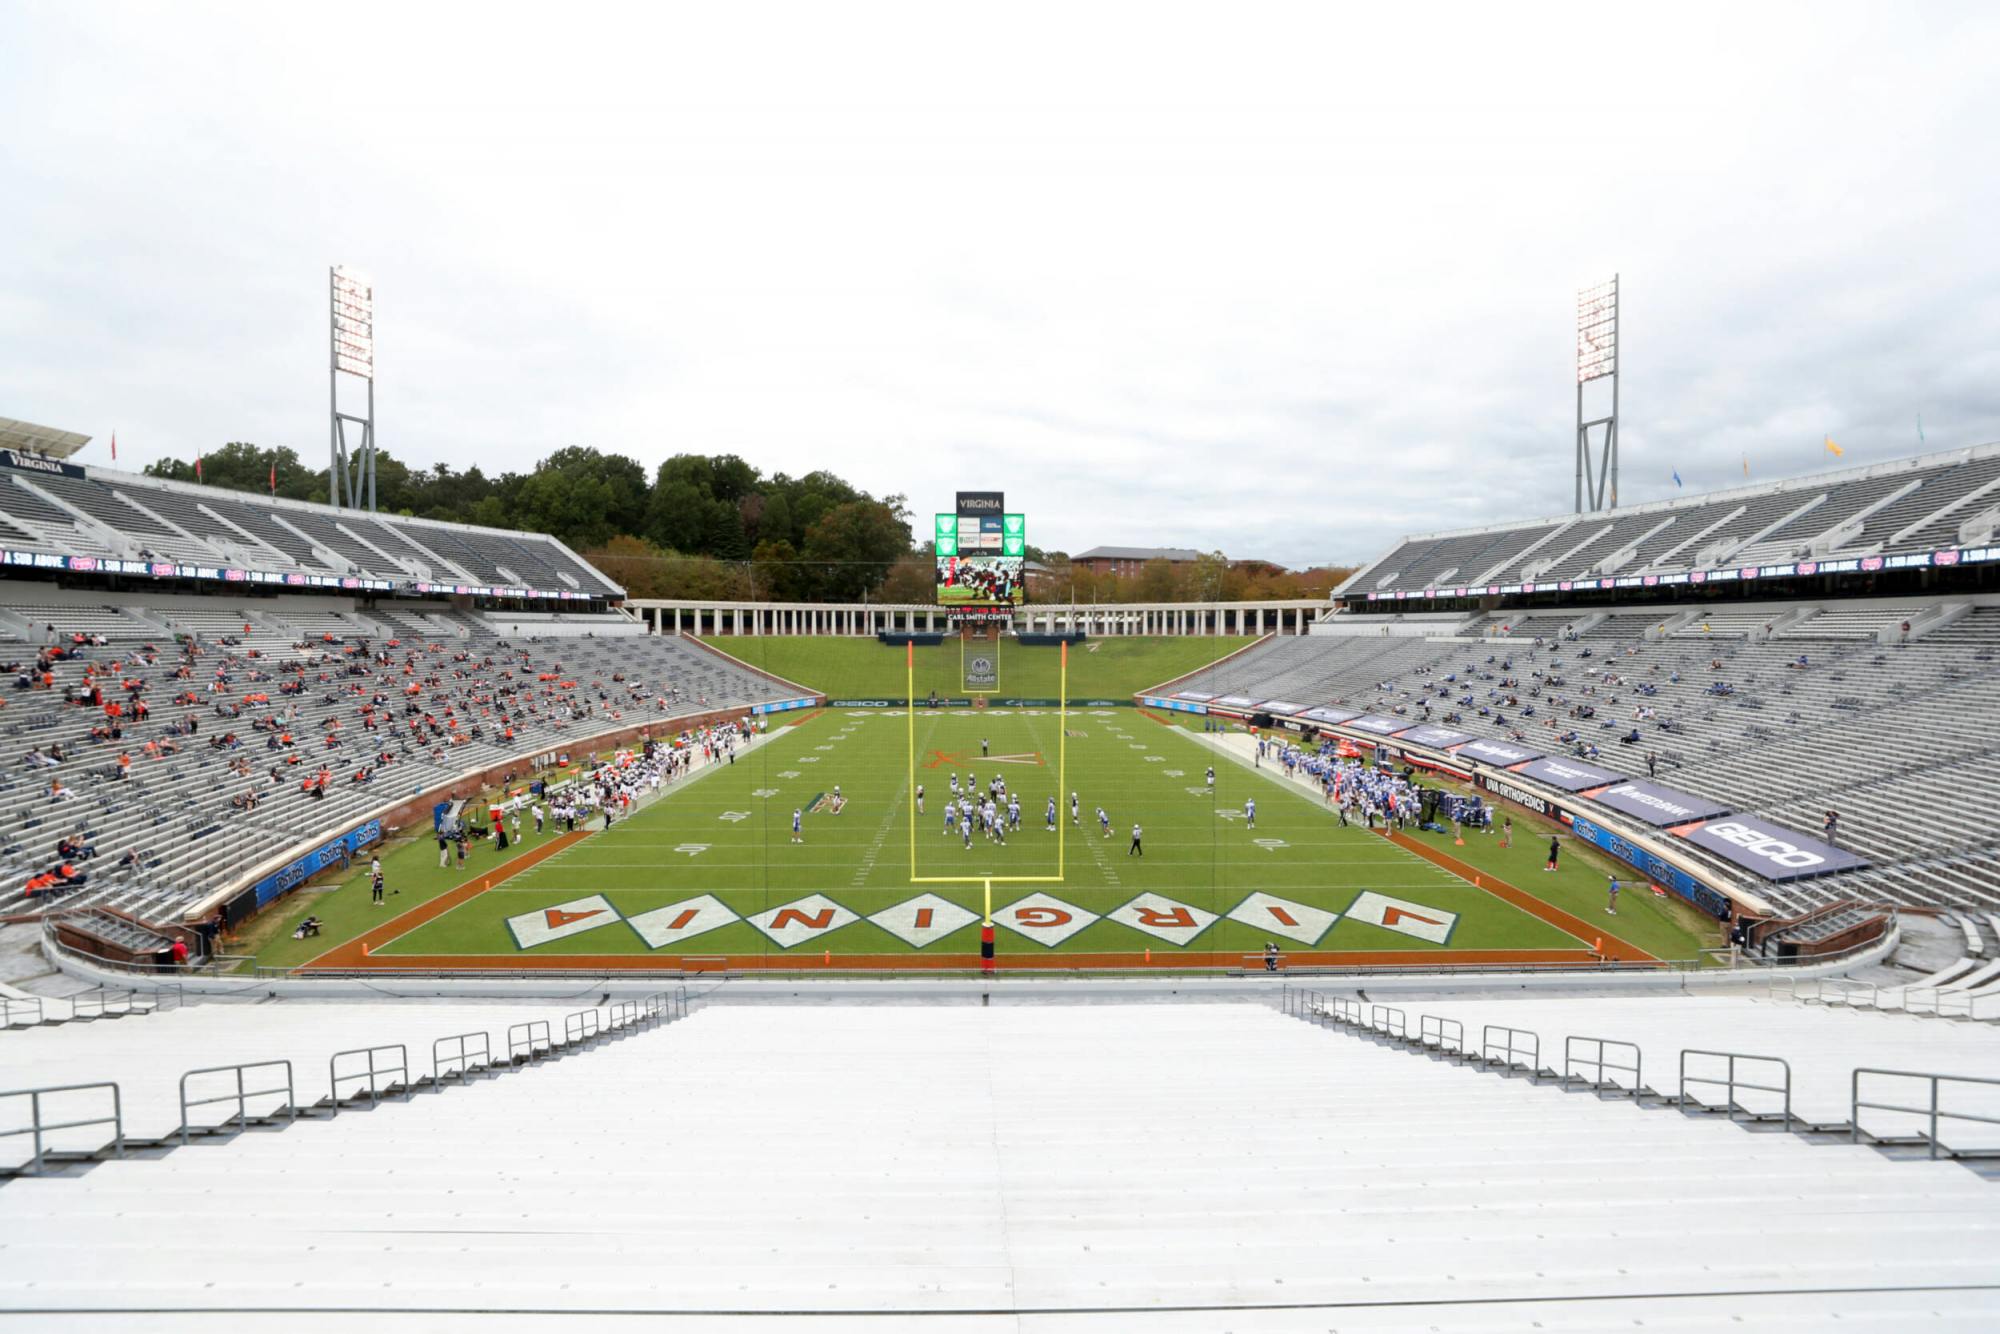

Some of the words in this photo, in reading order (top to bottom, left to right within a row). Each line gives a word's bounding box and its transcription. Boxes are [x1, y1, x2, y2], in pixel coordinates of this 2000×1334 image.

[10, 453, 63, 473] VIRGINIA
[960, 499, 1000, 508] VIRGINIA
[4, 551, 12, 564] A
[13, 552, 32, 565] SUB
[97, 559, 103, 570] A
[105, 560, 121, 571] SUB
[1486, 778, 1499, 792] UVA
[1500, 784, 1545, 813] ORTHOPEDICS
[1704, 822, 1825, 867] GEICO
